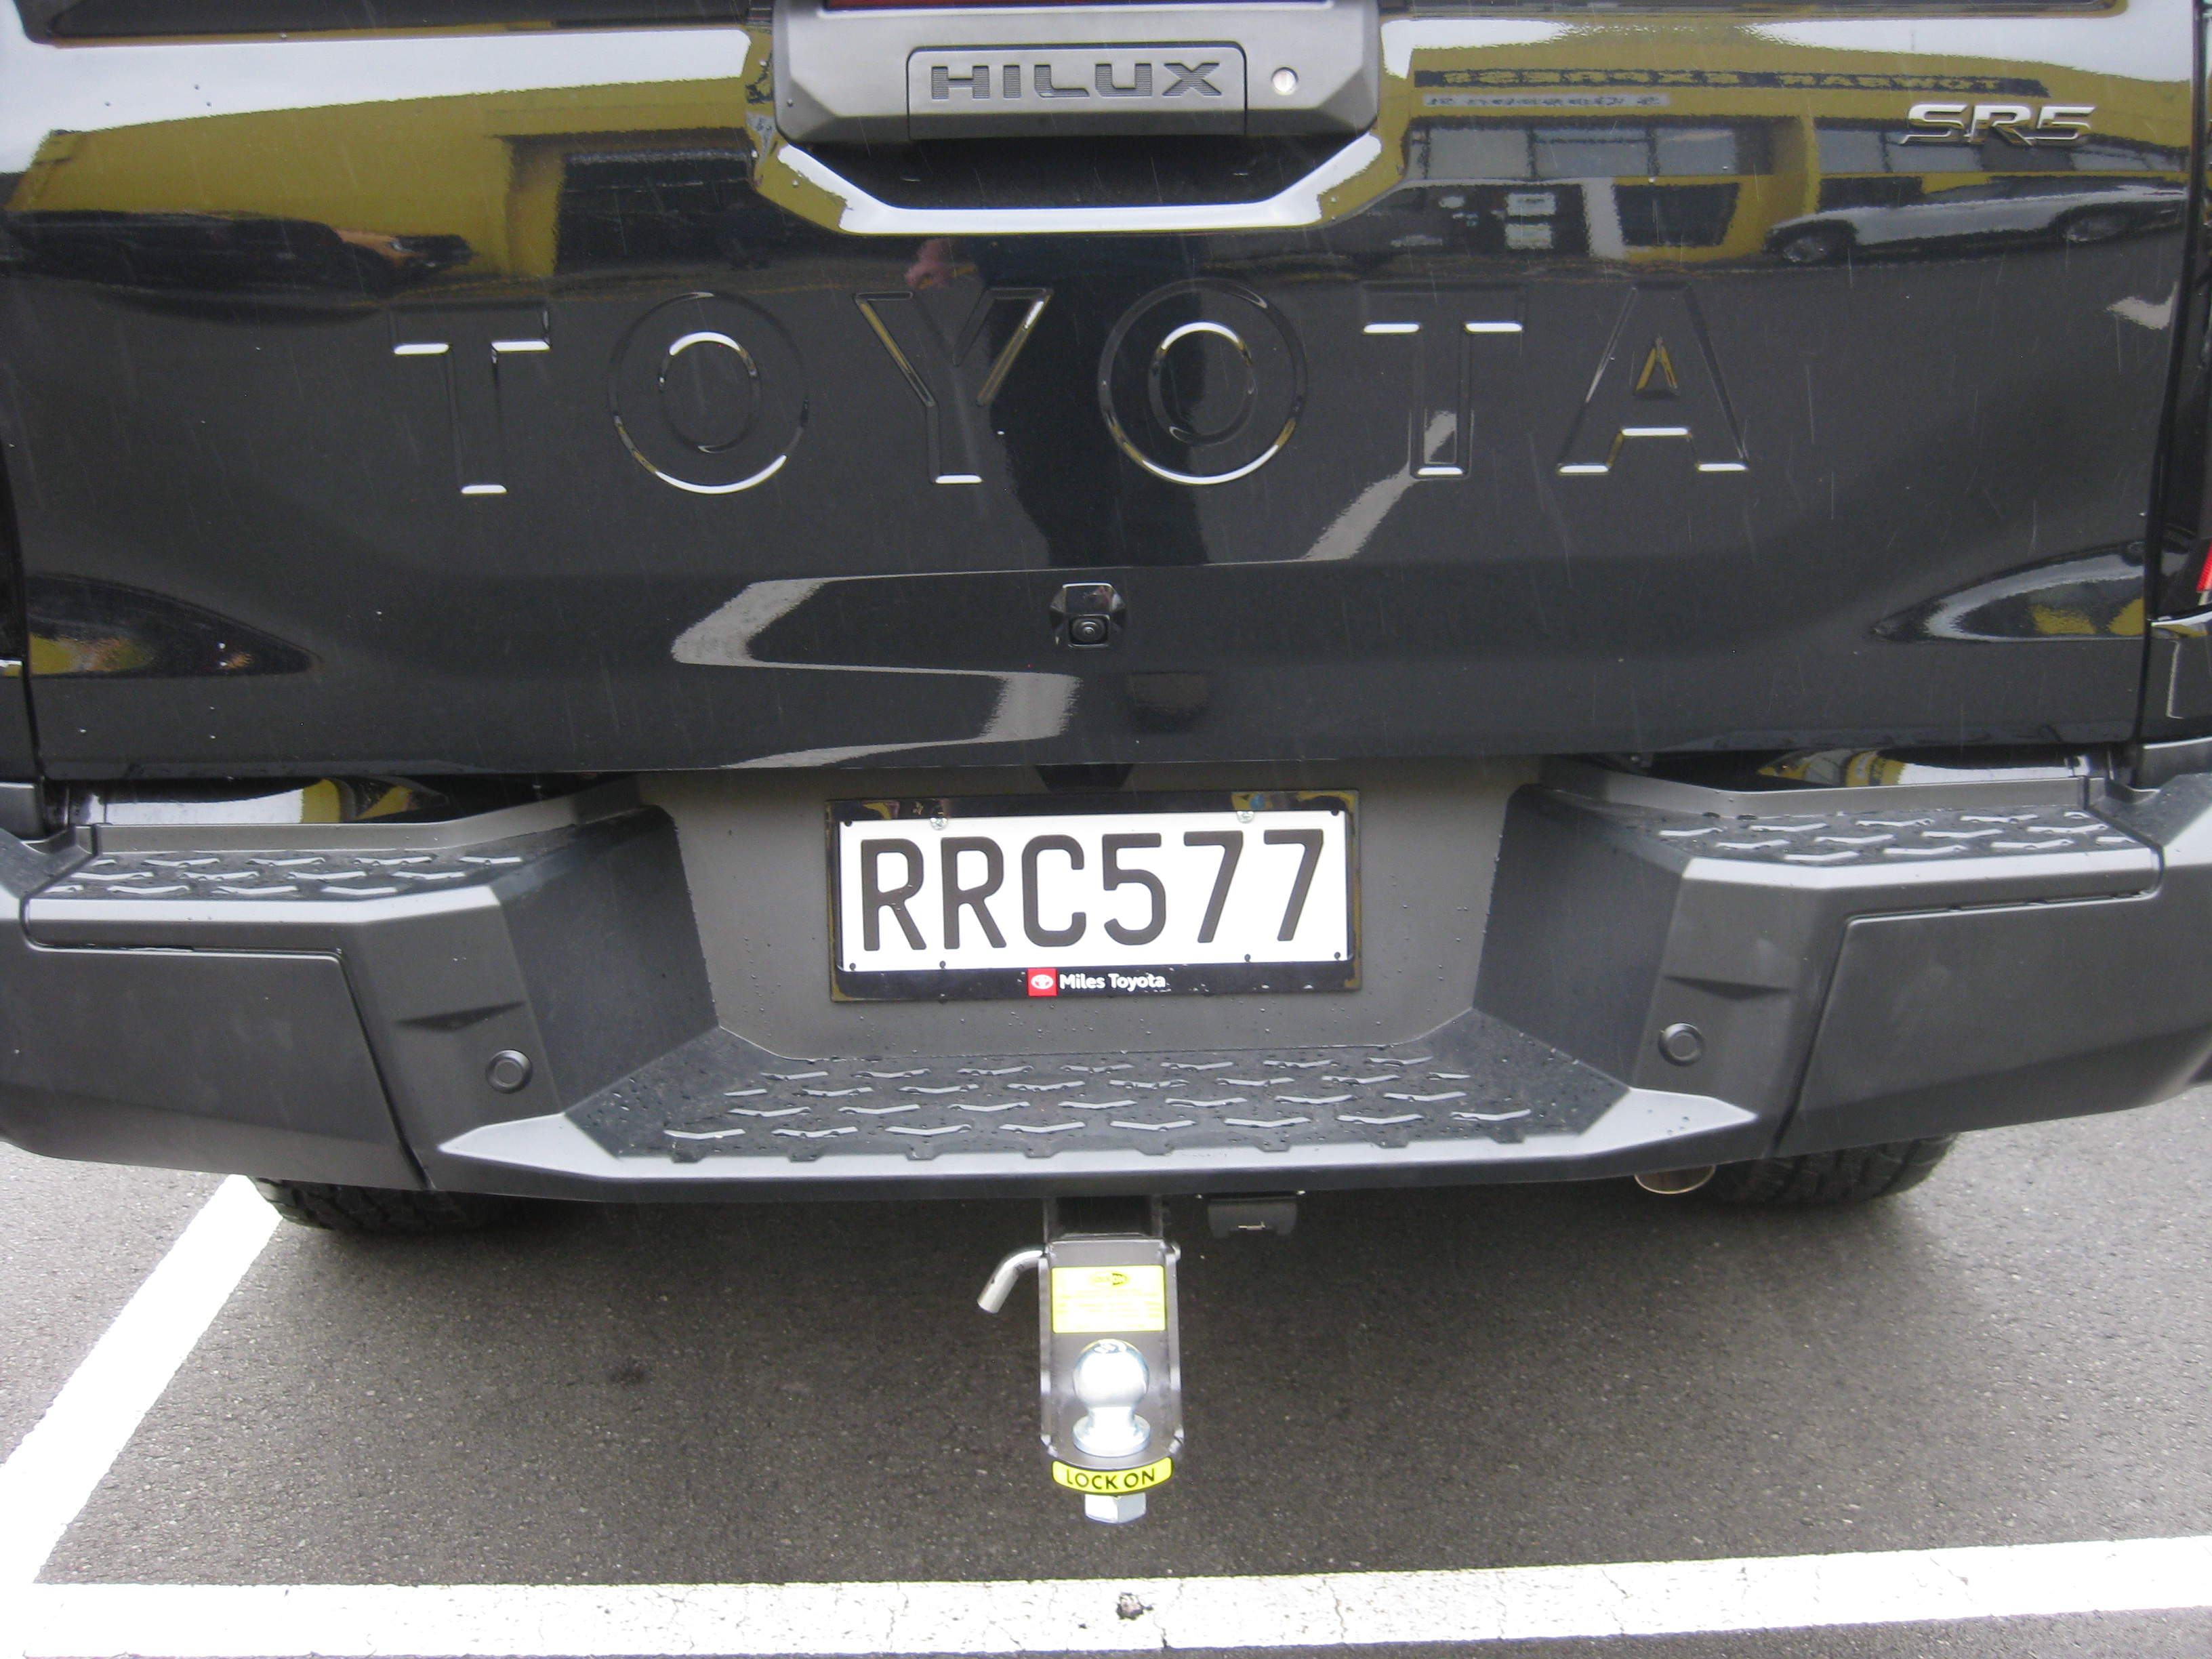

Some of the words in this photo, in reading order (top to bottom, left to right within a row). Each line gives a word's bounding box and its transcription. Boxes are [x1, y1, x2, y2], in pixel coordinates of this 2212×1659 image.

[931, 63, 1223, 99] HILUX
[1899, 103, 2095, 146] SR5
[388, 279, 1750, 494] TOYOTA
[860, 828, 1324, 951] RRC577
[1059, 972, 1106, 989] Miles
[1107, 972, 1166, 992] Toyota
[1066, 1469, 1118, 1490] LOCK
[1123, 1467, 1155, 1488] ON
